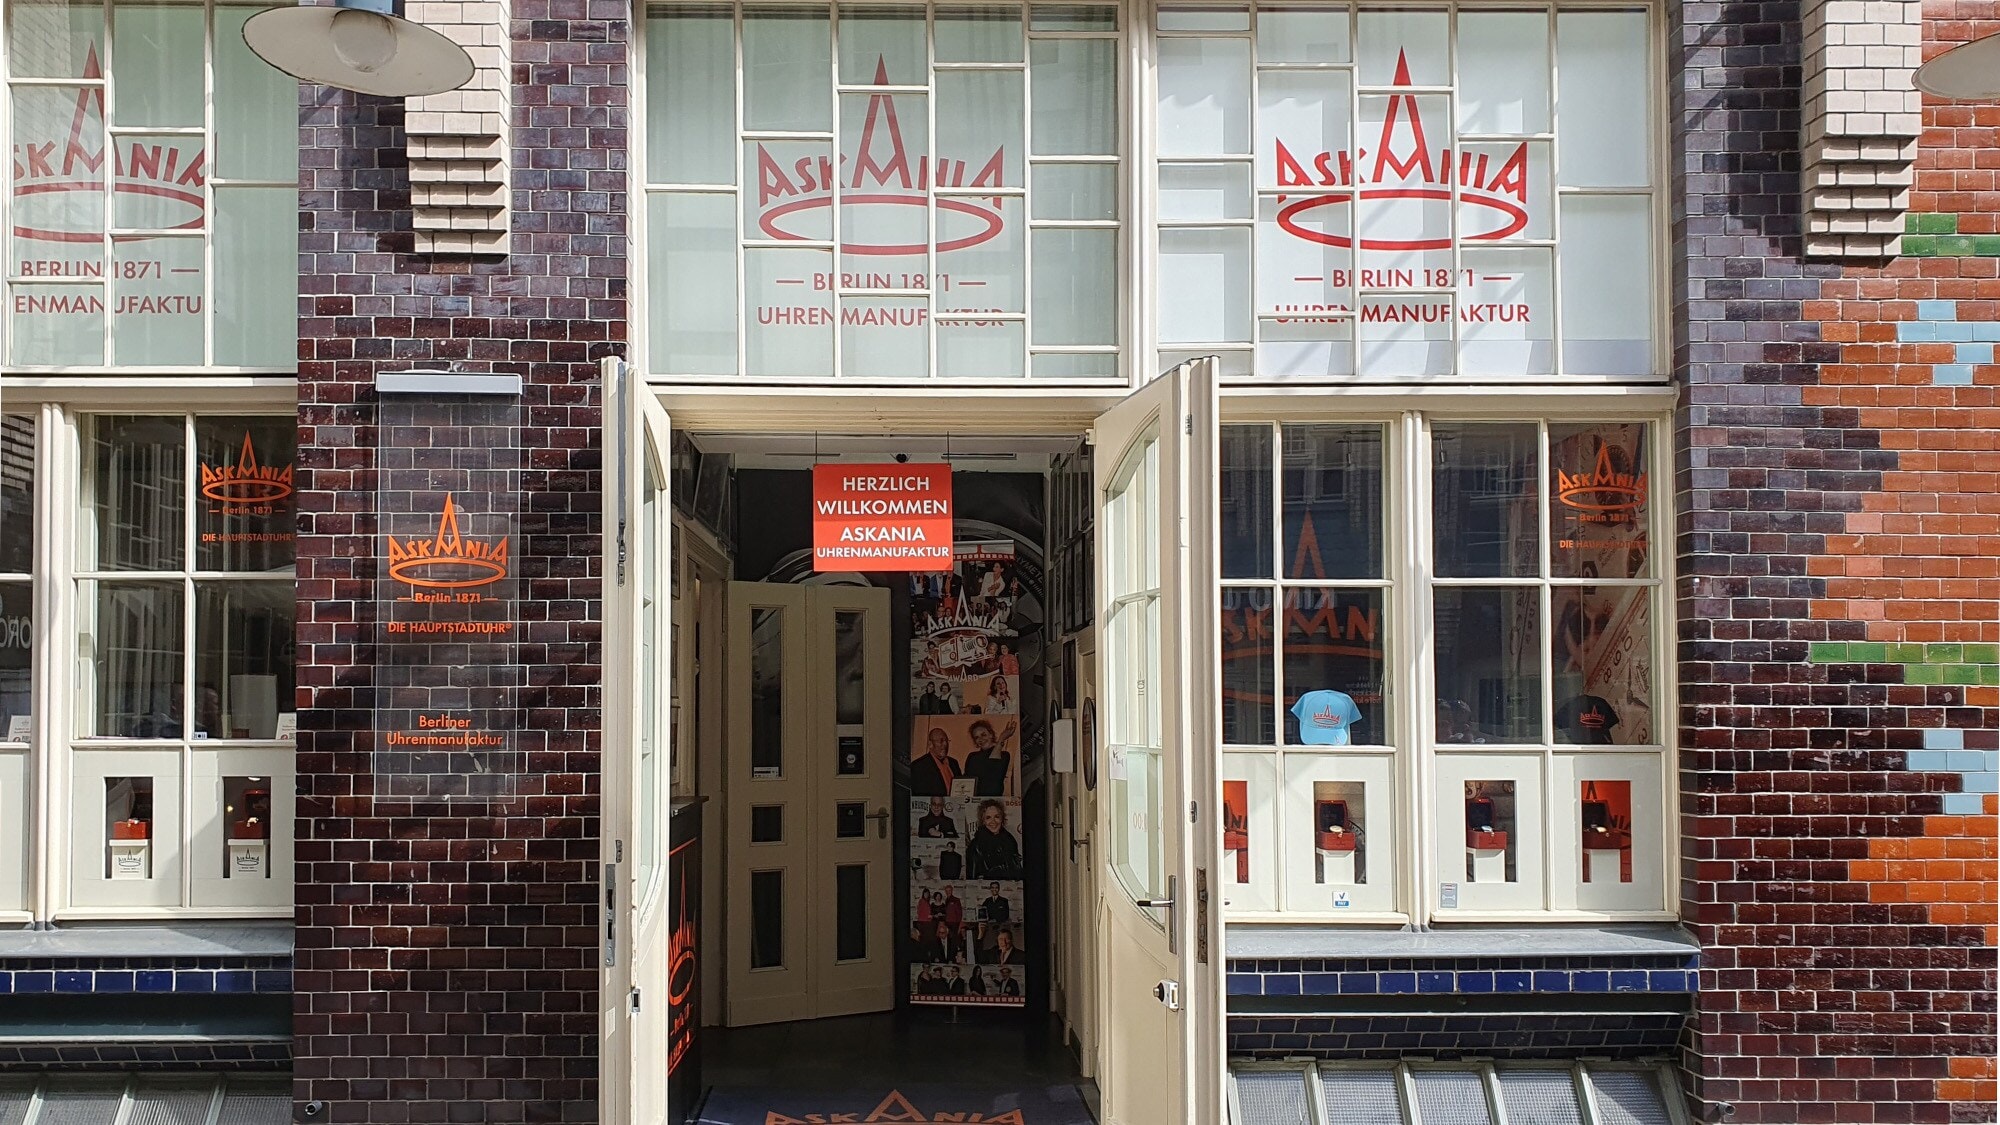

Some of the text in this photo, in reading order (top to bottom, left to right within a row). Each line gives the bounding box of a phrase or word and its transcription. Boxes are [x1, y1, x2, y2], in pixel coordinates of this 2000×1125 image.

[757, 53, 1004, 210] ASKANIA
[1275, 46, 1528, 204] ASKANIA
[20, 260, 161, 279] BERLIN 1871
[1333, 268, 1474, 288] BRLIN 181
[901, 273, 949, 292] 181
[15, 295, 217, 314] ENMANUFAKTU
[757, 306, 1005, 327] UHRENMANUFKTUR
[201, 430, 293, 486] ASKANIA
[1558, 439, 1648, 493] ASKANIA
[842, 476, 930, 491] HERZLICH
[222, 506, 272, 515] Berlin 1871
[816, 500, 948, 516] WILLKOMMEN
[388, 491, 508, 566] ASKANIA
[840, 526, 926, 542] ASKANIA
[202, 533, 216, 542] DIE
[1560, 540, 1574, 549] DIE
[816, 546, 949, 558] UHRENMANUFAKTUR
[415, 592, 481, 604] Berlin 1871
[927, 585, 1001, 634] ASKANIA
[388, 622, 406, 633] DIE
[949, 666, 979, 682] AWARD
[418, 715, 471, 728] Berliner
[387, 732, 503, 746] Uhrenmanufaktur
[766, 1089, 1025, 1125] ASKANIA
